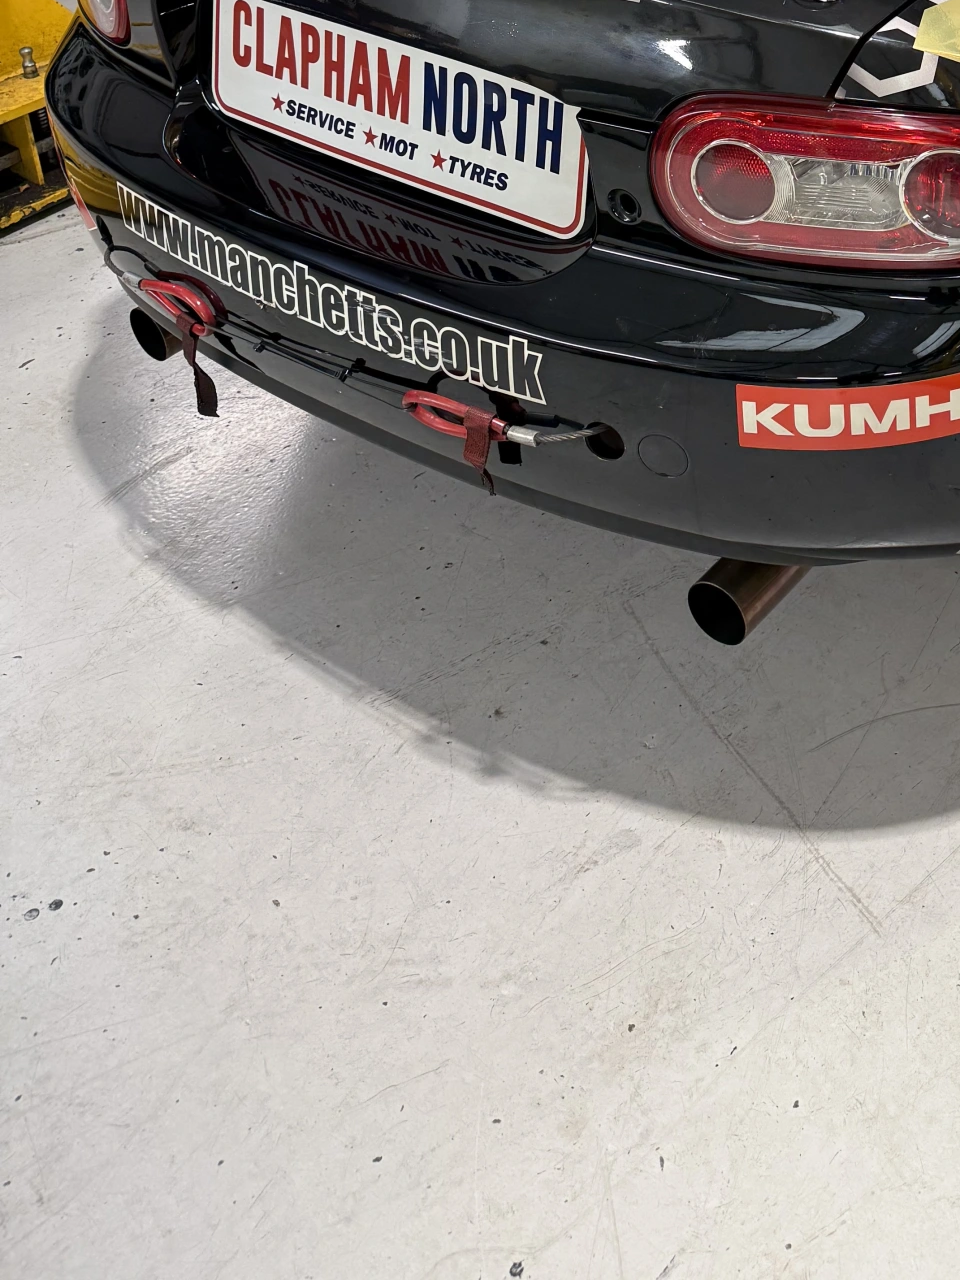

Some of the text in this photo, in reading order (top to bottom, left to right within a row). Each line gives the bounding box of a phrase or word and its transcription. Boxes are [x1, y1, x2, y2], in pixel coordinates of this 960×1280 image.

[232, 0, 564, 174] CLAPHAM NORTH
[285, 100, 510, 191] SERVICE MOT TYRES
[116, 181, 547, 406] www.manchetts.co.uk
